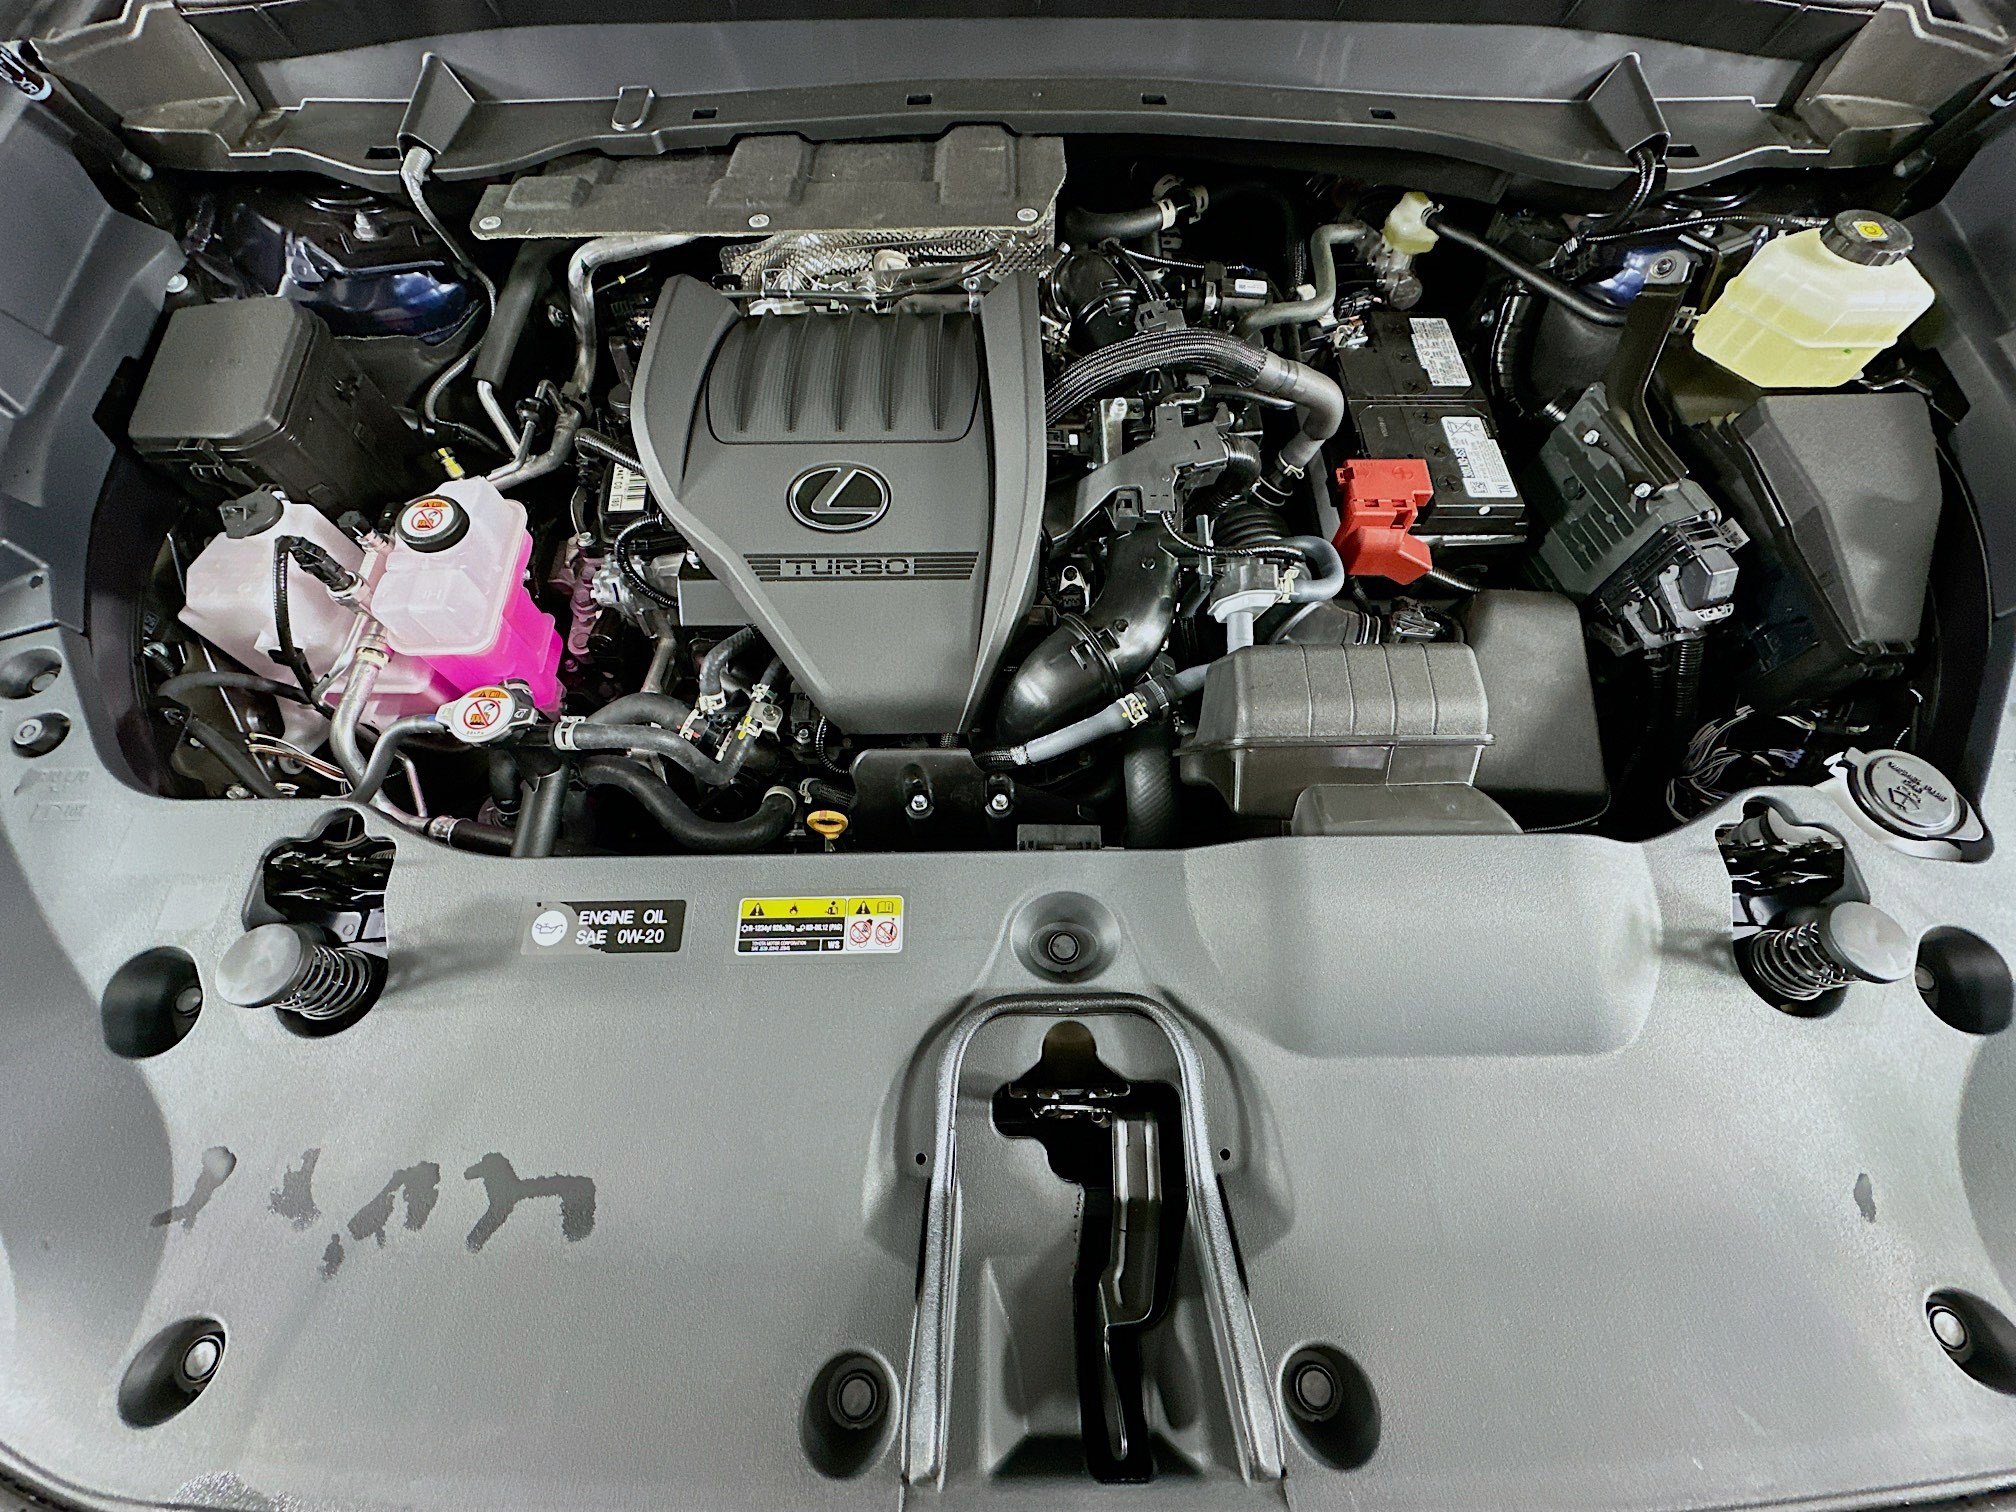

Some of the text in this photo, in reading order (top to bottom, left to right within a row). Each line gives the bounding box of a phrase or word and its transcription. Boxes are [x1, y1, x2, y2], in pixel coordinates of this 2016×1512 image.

[785, 558, 910, 576] TURBO
[578, 909, 668, 926] ENGINE OIL
[575, 928, 665, 945] SAE 0W-20
